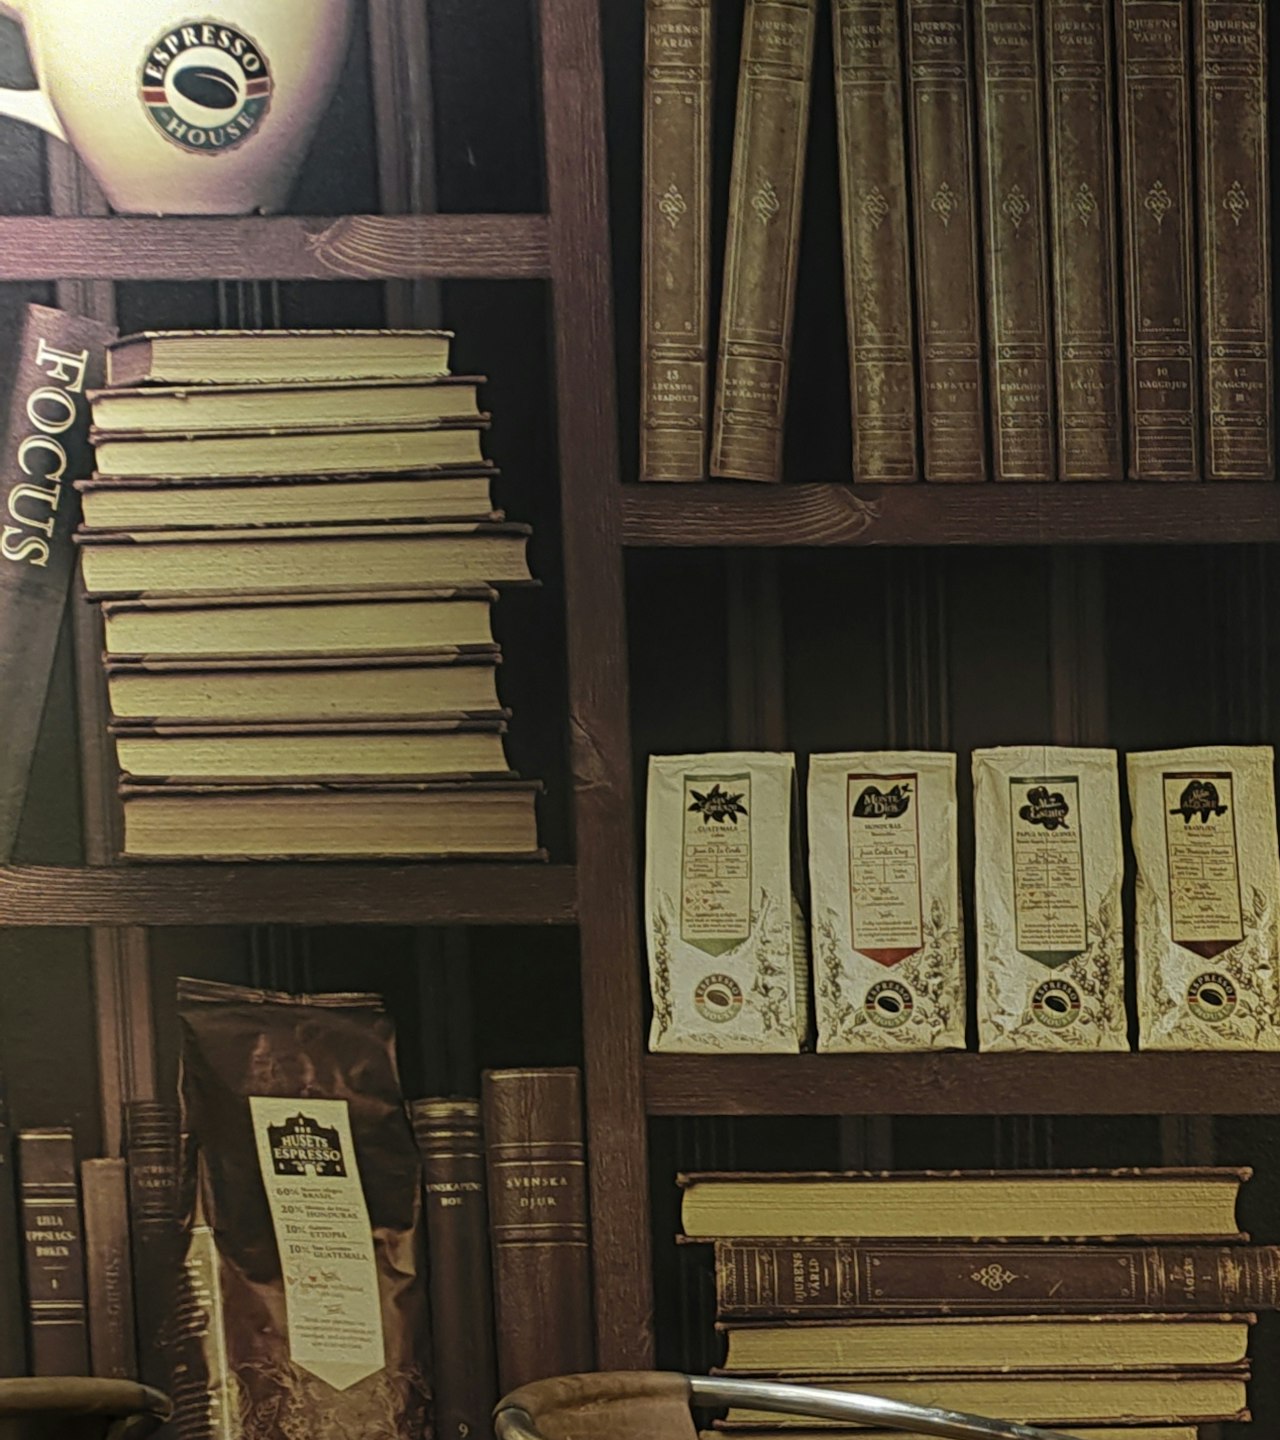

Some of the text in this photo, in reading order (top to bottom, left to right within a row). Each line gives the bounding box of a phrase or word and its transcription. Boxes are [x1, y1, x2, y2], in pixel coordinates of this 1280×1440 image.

[146, 24, 261, 81] ESPRESSO
[166, 115, 255, 146] HOUSE
[1, 338, 89, 567] FOCUS
[867, 981, 910, 1003] ESPRESSO
[1190, 975, 1234, 996] ESPRESSO
[274, 1148, 341, 1162] ESPRESSO
[505, 1177, 568, 1188] SVENSKA
[276, 1186, 300, 1197] 60%
[280, 1205, 304, 1214] 20%
[520, 1197, 556, 1208] DJUR
